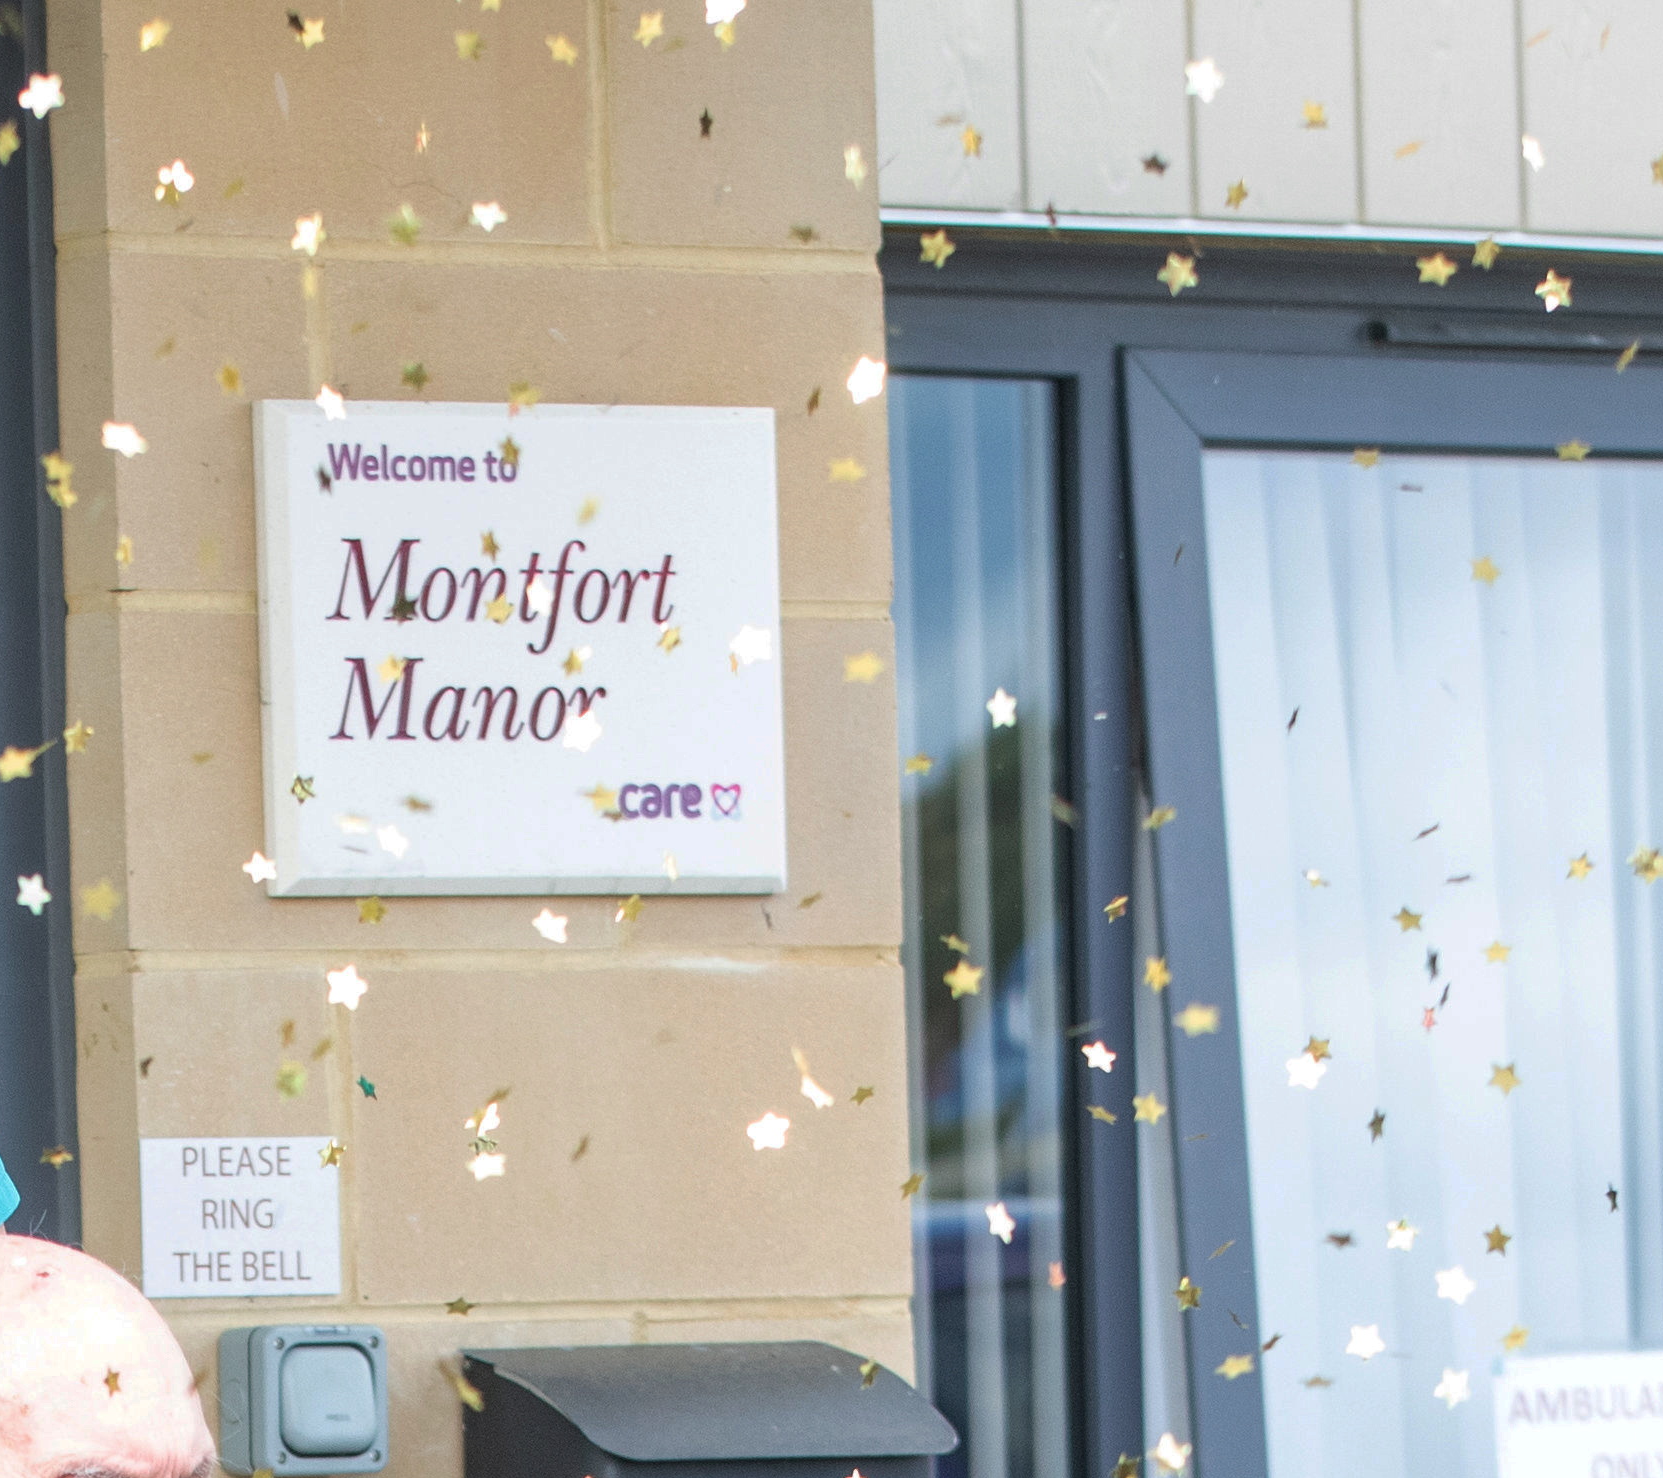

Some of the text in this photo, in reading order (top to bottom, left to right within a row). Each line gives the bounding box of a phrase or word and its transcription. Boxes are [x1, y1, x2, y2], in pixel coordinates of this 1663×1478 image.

[326, 443, 517, 482] Welcome to
[326, 538, 677, 654] Montfort
[330, 657, 607, 741] Manor
[619, 783, 702, 819] care
[181, 1146, 292, 1178] PLEASE
[202, 1199, 274, 1230] RING
[173, 1251, 311, 1283] THE BELL
